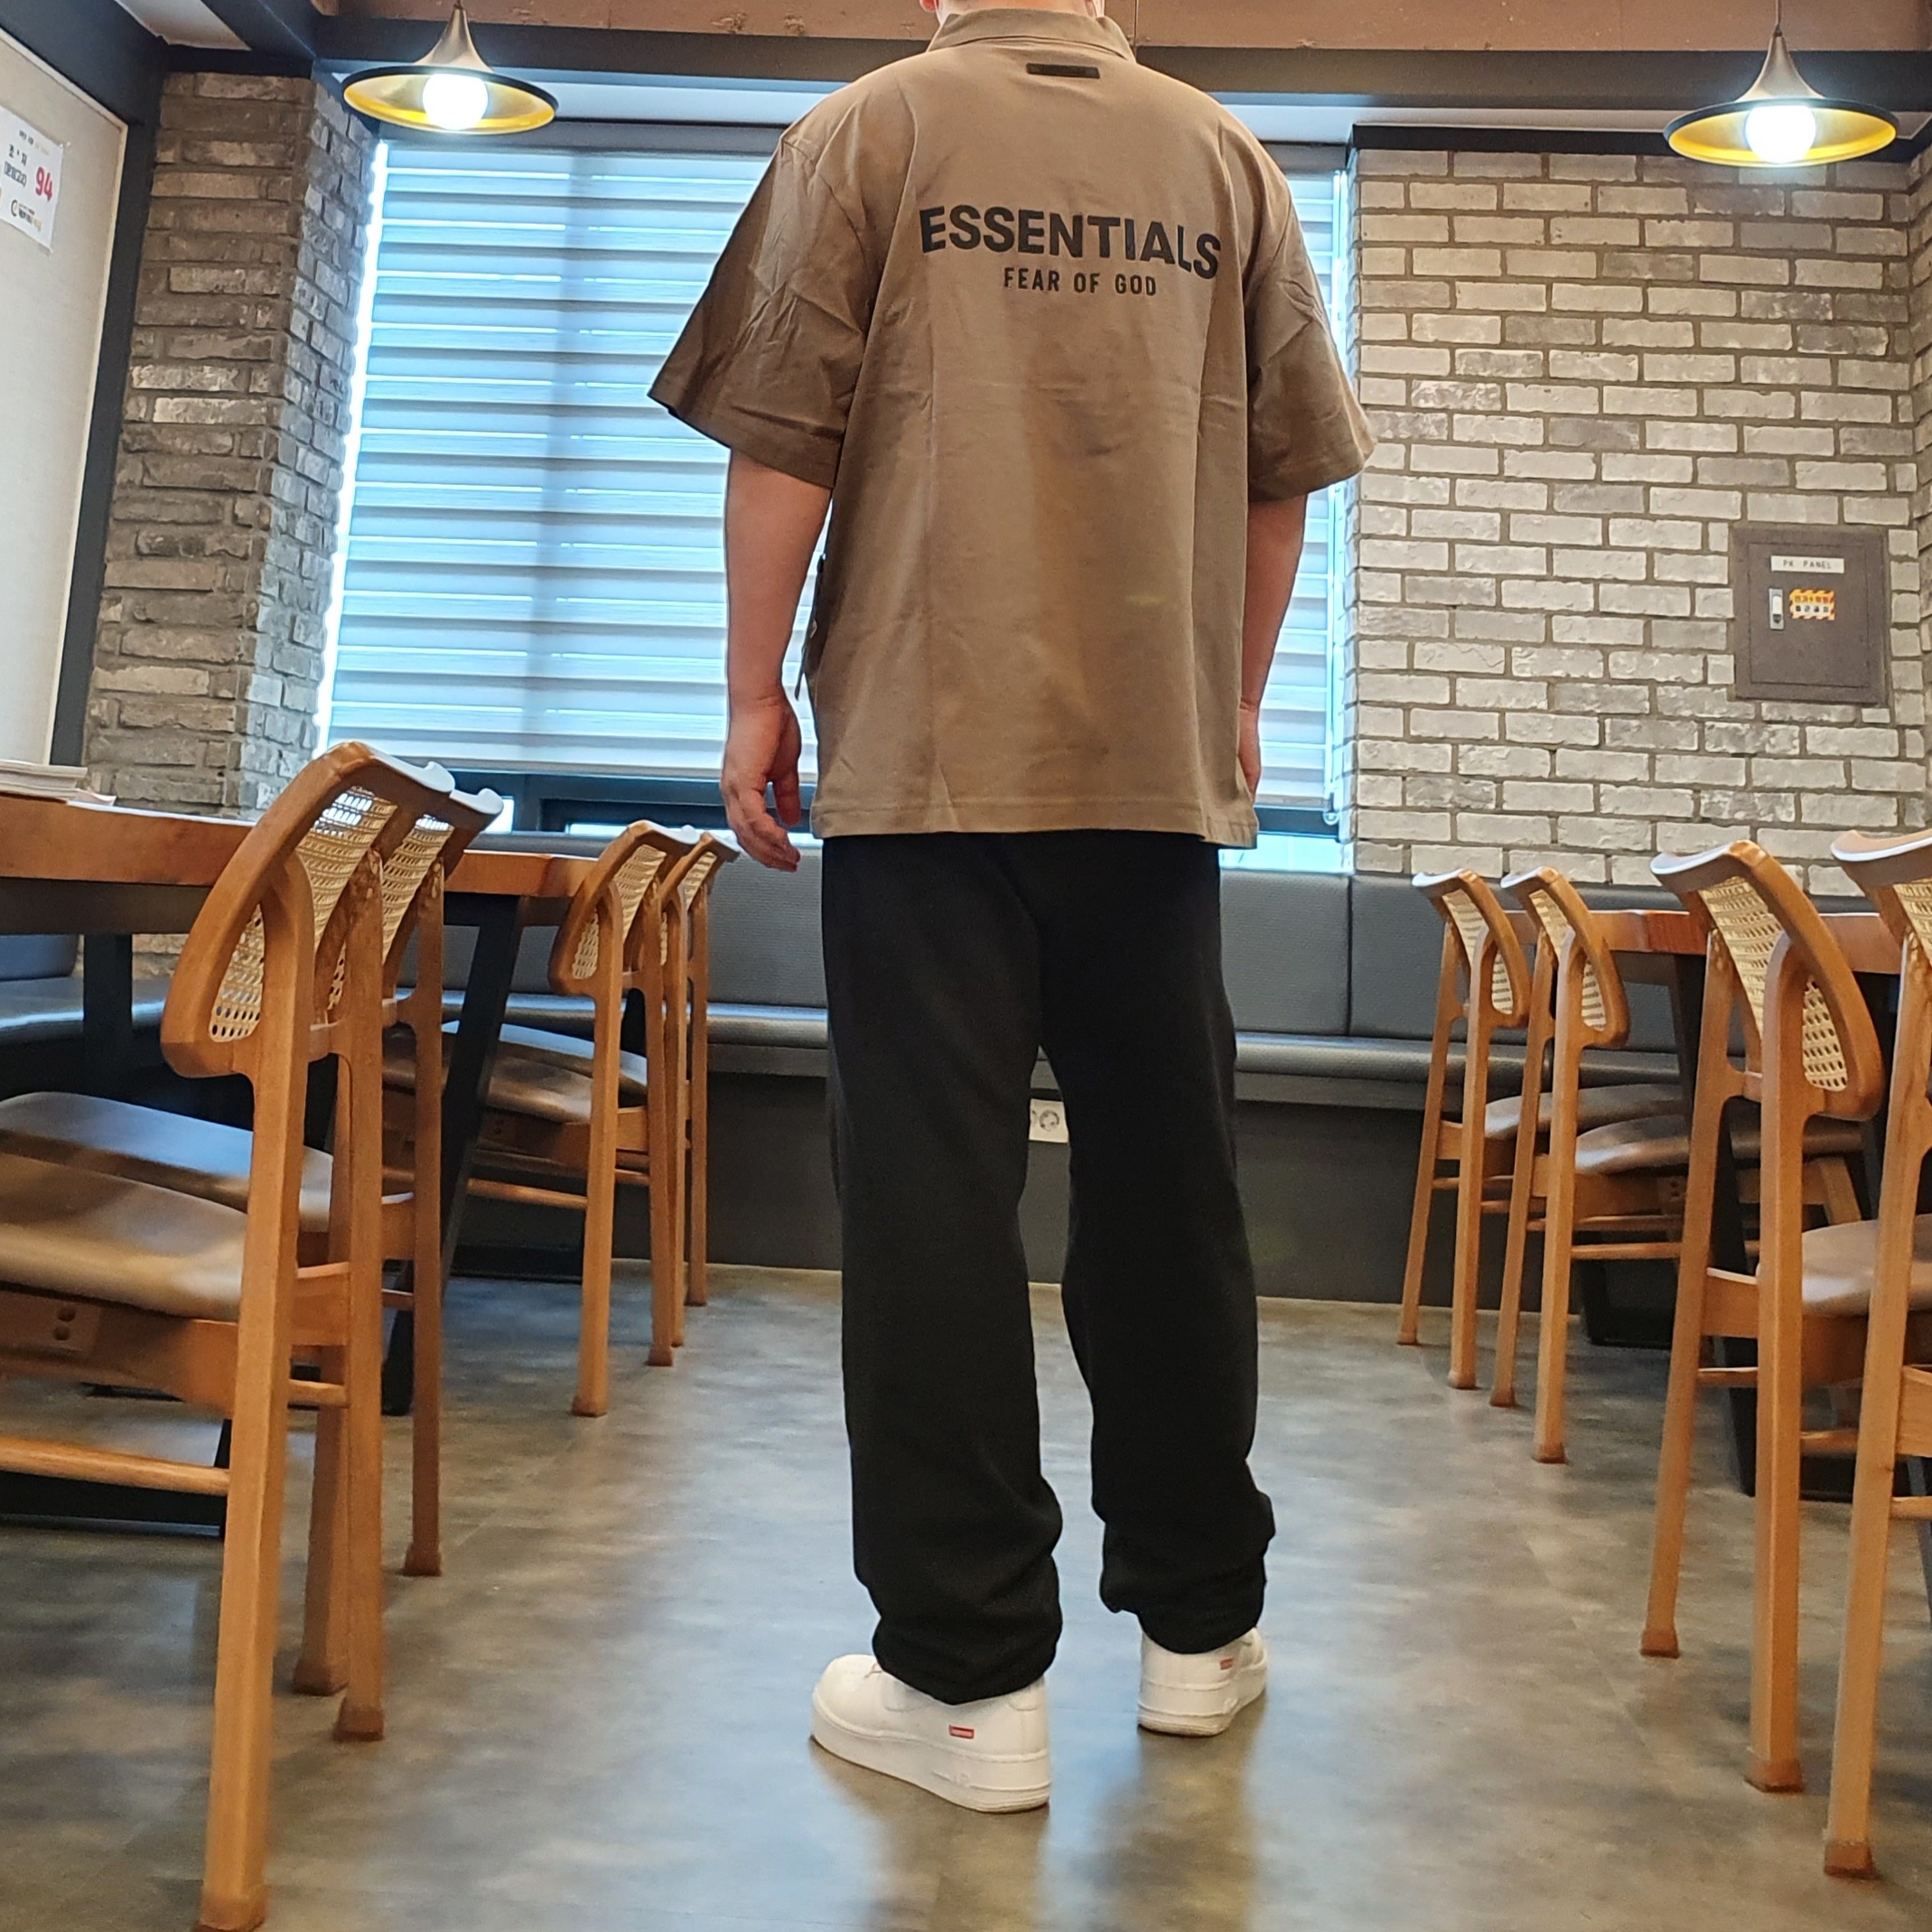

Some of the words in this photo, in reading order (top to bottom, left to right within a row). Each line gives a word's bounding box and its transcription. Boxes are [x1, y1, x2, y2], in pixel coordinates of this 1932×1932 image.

[35, 166, 52, 202] 94
[919, 205, 1221, 280] ESSENTIALS
[1003, 267, 1059, 292] FEAR
[1073, 273, 1100, 294] OF
[1115, 274, 1157, 296] GOD
